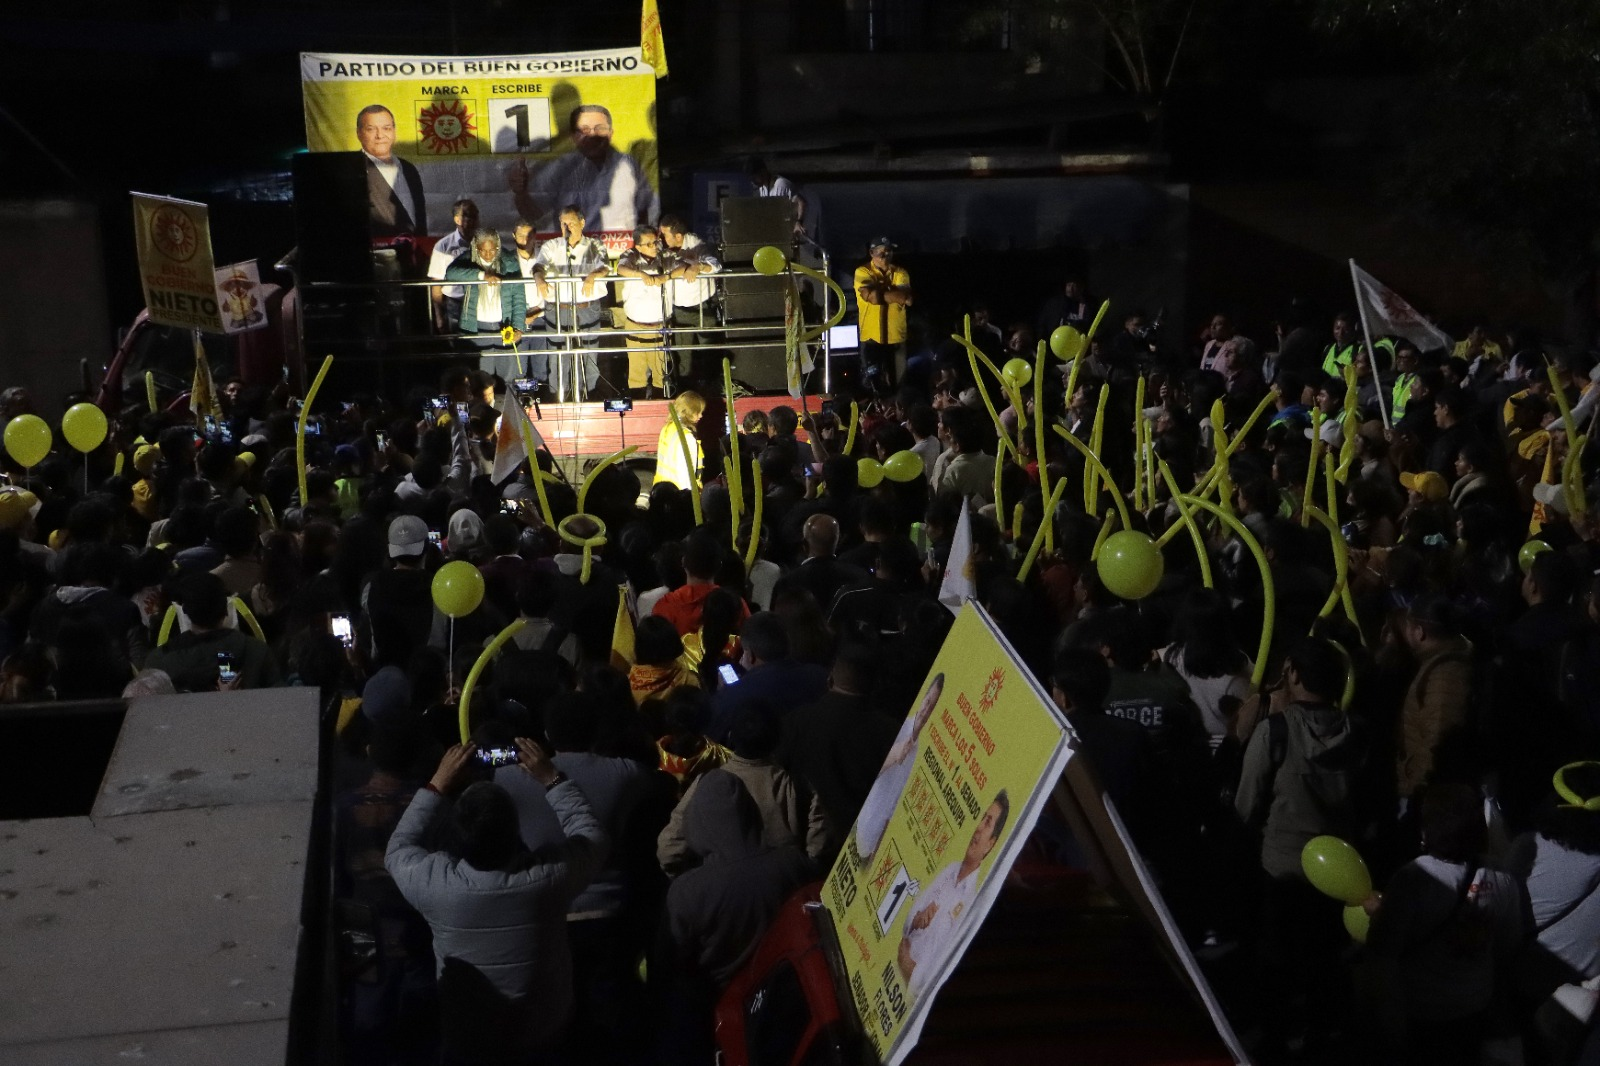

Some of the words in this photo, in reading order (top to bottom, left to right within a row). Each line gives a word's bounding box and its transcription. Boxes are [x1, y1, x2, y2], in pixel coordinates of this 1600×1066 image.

[319, 62, 416, 77] PARTIDO
[421, 61, 458, 75] DEL
[464, 61, 520, 75] BUEN
[526, 56, 638, 73] GOBIERNO
[421, 85, 469, 95] MARCA
[492, 84, 543, 94] ESCRIBE
[504, 104, 531, 147] 1
[146, 275, 215, 295] GOBIERNO
[161, 263, 197, 279] BUEN
[149, 288, 218, 316] NIETO
[151, 308, 221, 328] PRESIDENTE
[941, 708, 959, 741] MARCA
[957, 691, 972, 718] BUEN
[968, 711, 996, 757] GOBIERNO
[1105, 706, 1163, 727] ORCE
[955, 732, 968, 756] LOS
[964, 742, 976, 764] 5
[923, 745, 946, 790] REGIONAL
[942, 782, 965, 829] AREQUIPA
[969, 757, 988, 791] SOLES
[960, 781, 981, 821] SENADO
[836, 852, 858, 909] NIETO
[883, 881, 907, 924] 1
[852, 969, 869, 1016] SENADOR
[882, 960, 907, 1024] NILSON
[873, 987, 893, 1037] FLORES
